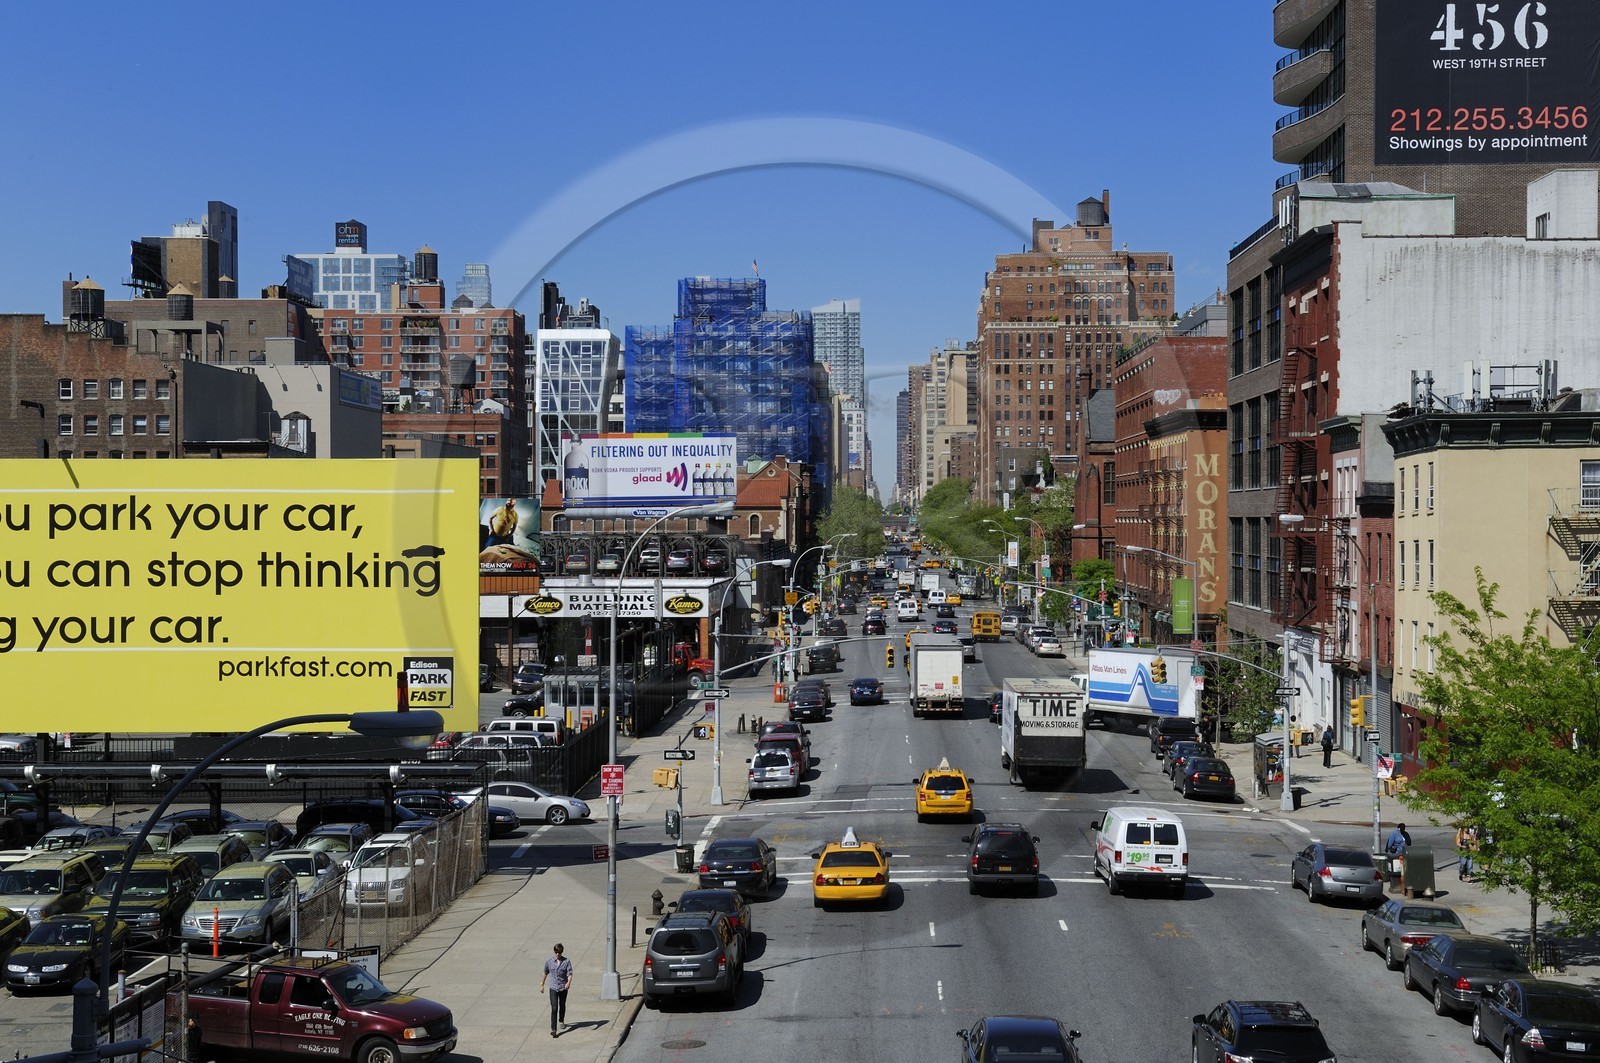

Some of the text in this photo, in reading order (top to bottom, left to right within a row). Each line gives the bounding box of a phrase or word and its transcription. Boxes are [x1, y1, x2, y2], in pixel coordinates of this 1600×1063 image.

[1430, 2, 1549, 50] 456
[1432, 57, 1547, 69] WEST 19TH STREET
[1390, 105, 1588, 132] 212.255.3456
[1389, 134, 1588, 151] Showings by appointment
[591, 444, 733, 458] FILTERING OUT INEQUALITY
[632, 473, 662, 485] glaad
[49, 495, 152, 540] park
[165, 503, 269, 540] your
[283, 503, 363, 539] car,
[1193, 454, 1220, 603] MORAN'S
[47, 559, 130, 588] can
[147, 551, 243, 596] stop
[257, 550, 441, 597] thinking
[529, 598, 560, 609] Kamco
[668, 598, 700, 609] Kamco
[32, 616, 136, 652] your
[149, 615, 229, 644] car.
[218, 655, 393, 681] parkfast.com
[410, 660, 438, 668] Edison
[1091, 664, 1127, 674] Atlas Van Lines
[410, 673, 448, 684] PARK
[410, 691, 447, 702] FAST
[1029, 699, 1077, 717] TIME
[294, 1013, 312, 1022] EAGLE
